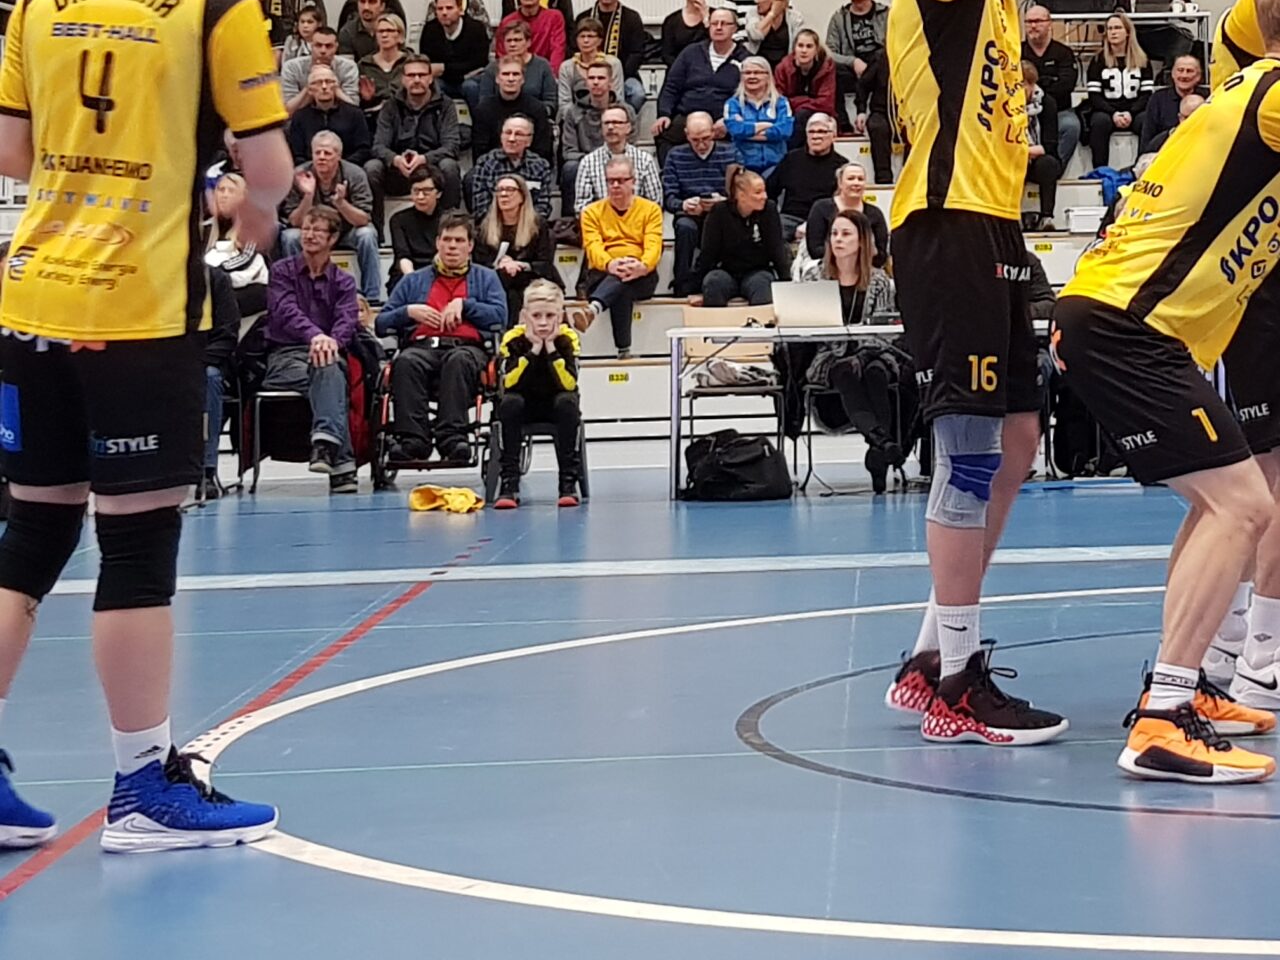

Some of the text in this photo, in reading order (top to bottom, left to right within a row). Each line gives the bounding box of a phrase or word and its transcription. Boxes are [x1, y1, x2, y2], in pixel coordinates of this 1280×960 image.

[79, 50, 115, 134] 4
[1101, 67, 1140, 99] 36
[968, 355, 997, 391] 16
[1191, 408, 1218, 442] 1
[1239, 403, 1270, 422] STYLE
[1121, 430, 1157, 451] STYLE
